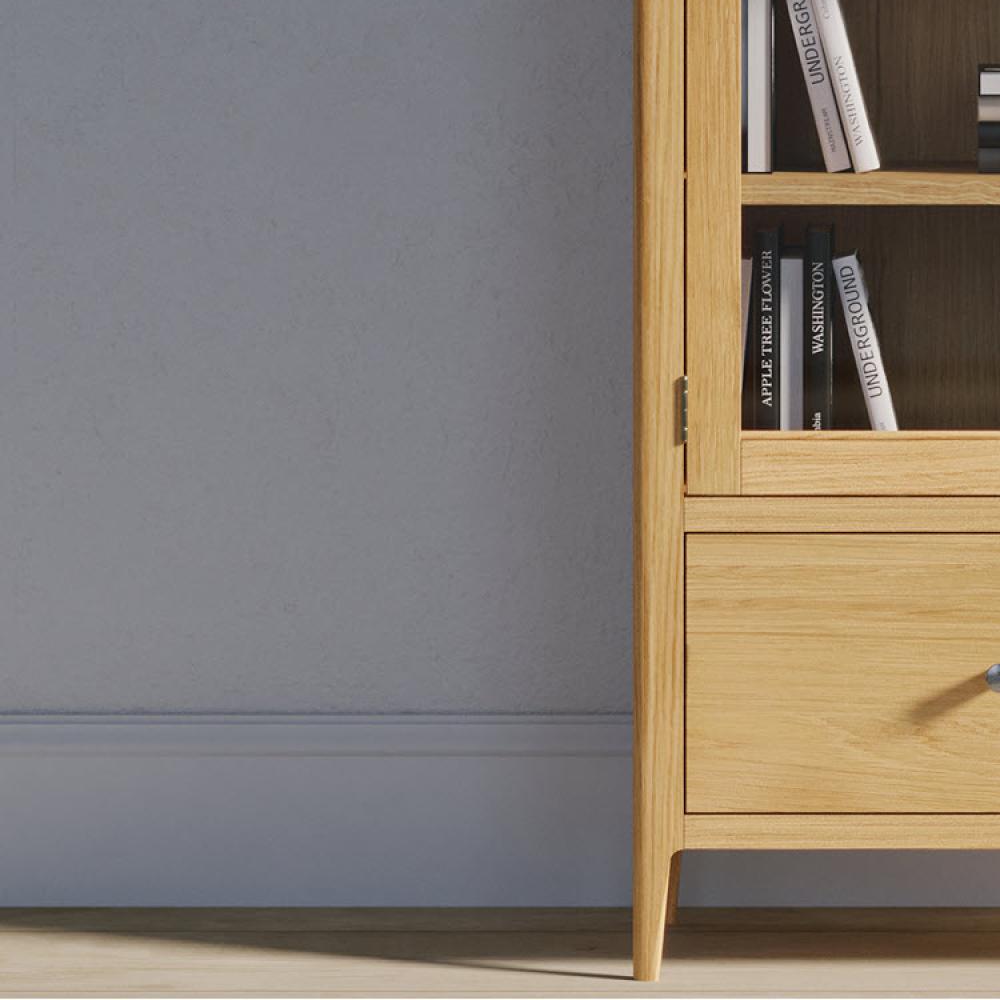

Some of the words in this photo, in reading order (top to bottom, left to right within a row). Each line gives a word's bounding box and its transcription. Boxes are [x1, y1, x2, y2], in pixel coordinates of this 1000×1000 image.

[833, 55, 863, 147] WASHINGTON
[761, 250, 772, 312] FLOWER
[812, 262, 824, 355] WASHINGTON
[761, 314, 772, 357] TREE
[840, 266, 883, 398] UNDERGROUND
[761, 359, 772, 407] APPLE
